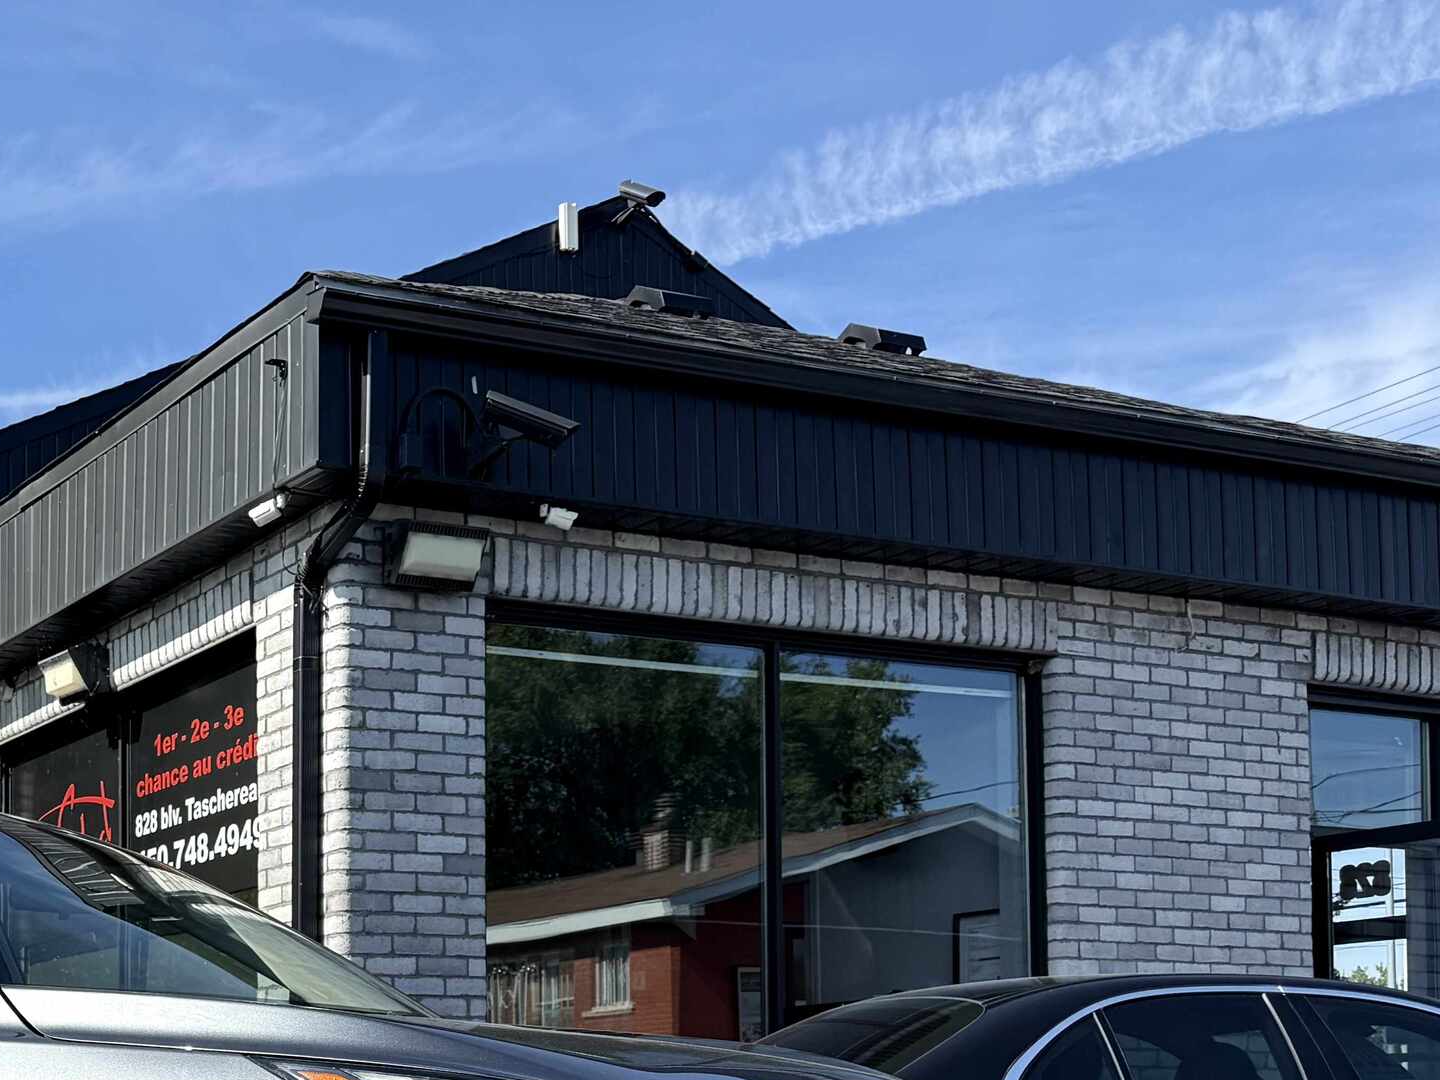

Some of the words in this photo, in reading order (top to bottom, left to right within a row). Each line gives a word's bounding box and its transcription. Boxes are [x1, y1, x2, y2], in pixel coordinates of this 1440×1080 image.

[154, 733, 178, 757] 1er
[190, 718, 210, 744] 2e
[223, 704, 245, 730] 3e
[136, 764, 190, 798] chance
[193, 755, 212, 779] au
[216, 732, 259, 769] crédi
[135, 809, 158, 838] 828
[160, 803, 183, 830] blv.
[185, 782, 258, 822] Tascherea
[140, 818, 261, 870] 0.748.4949
